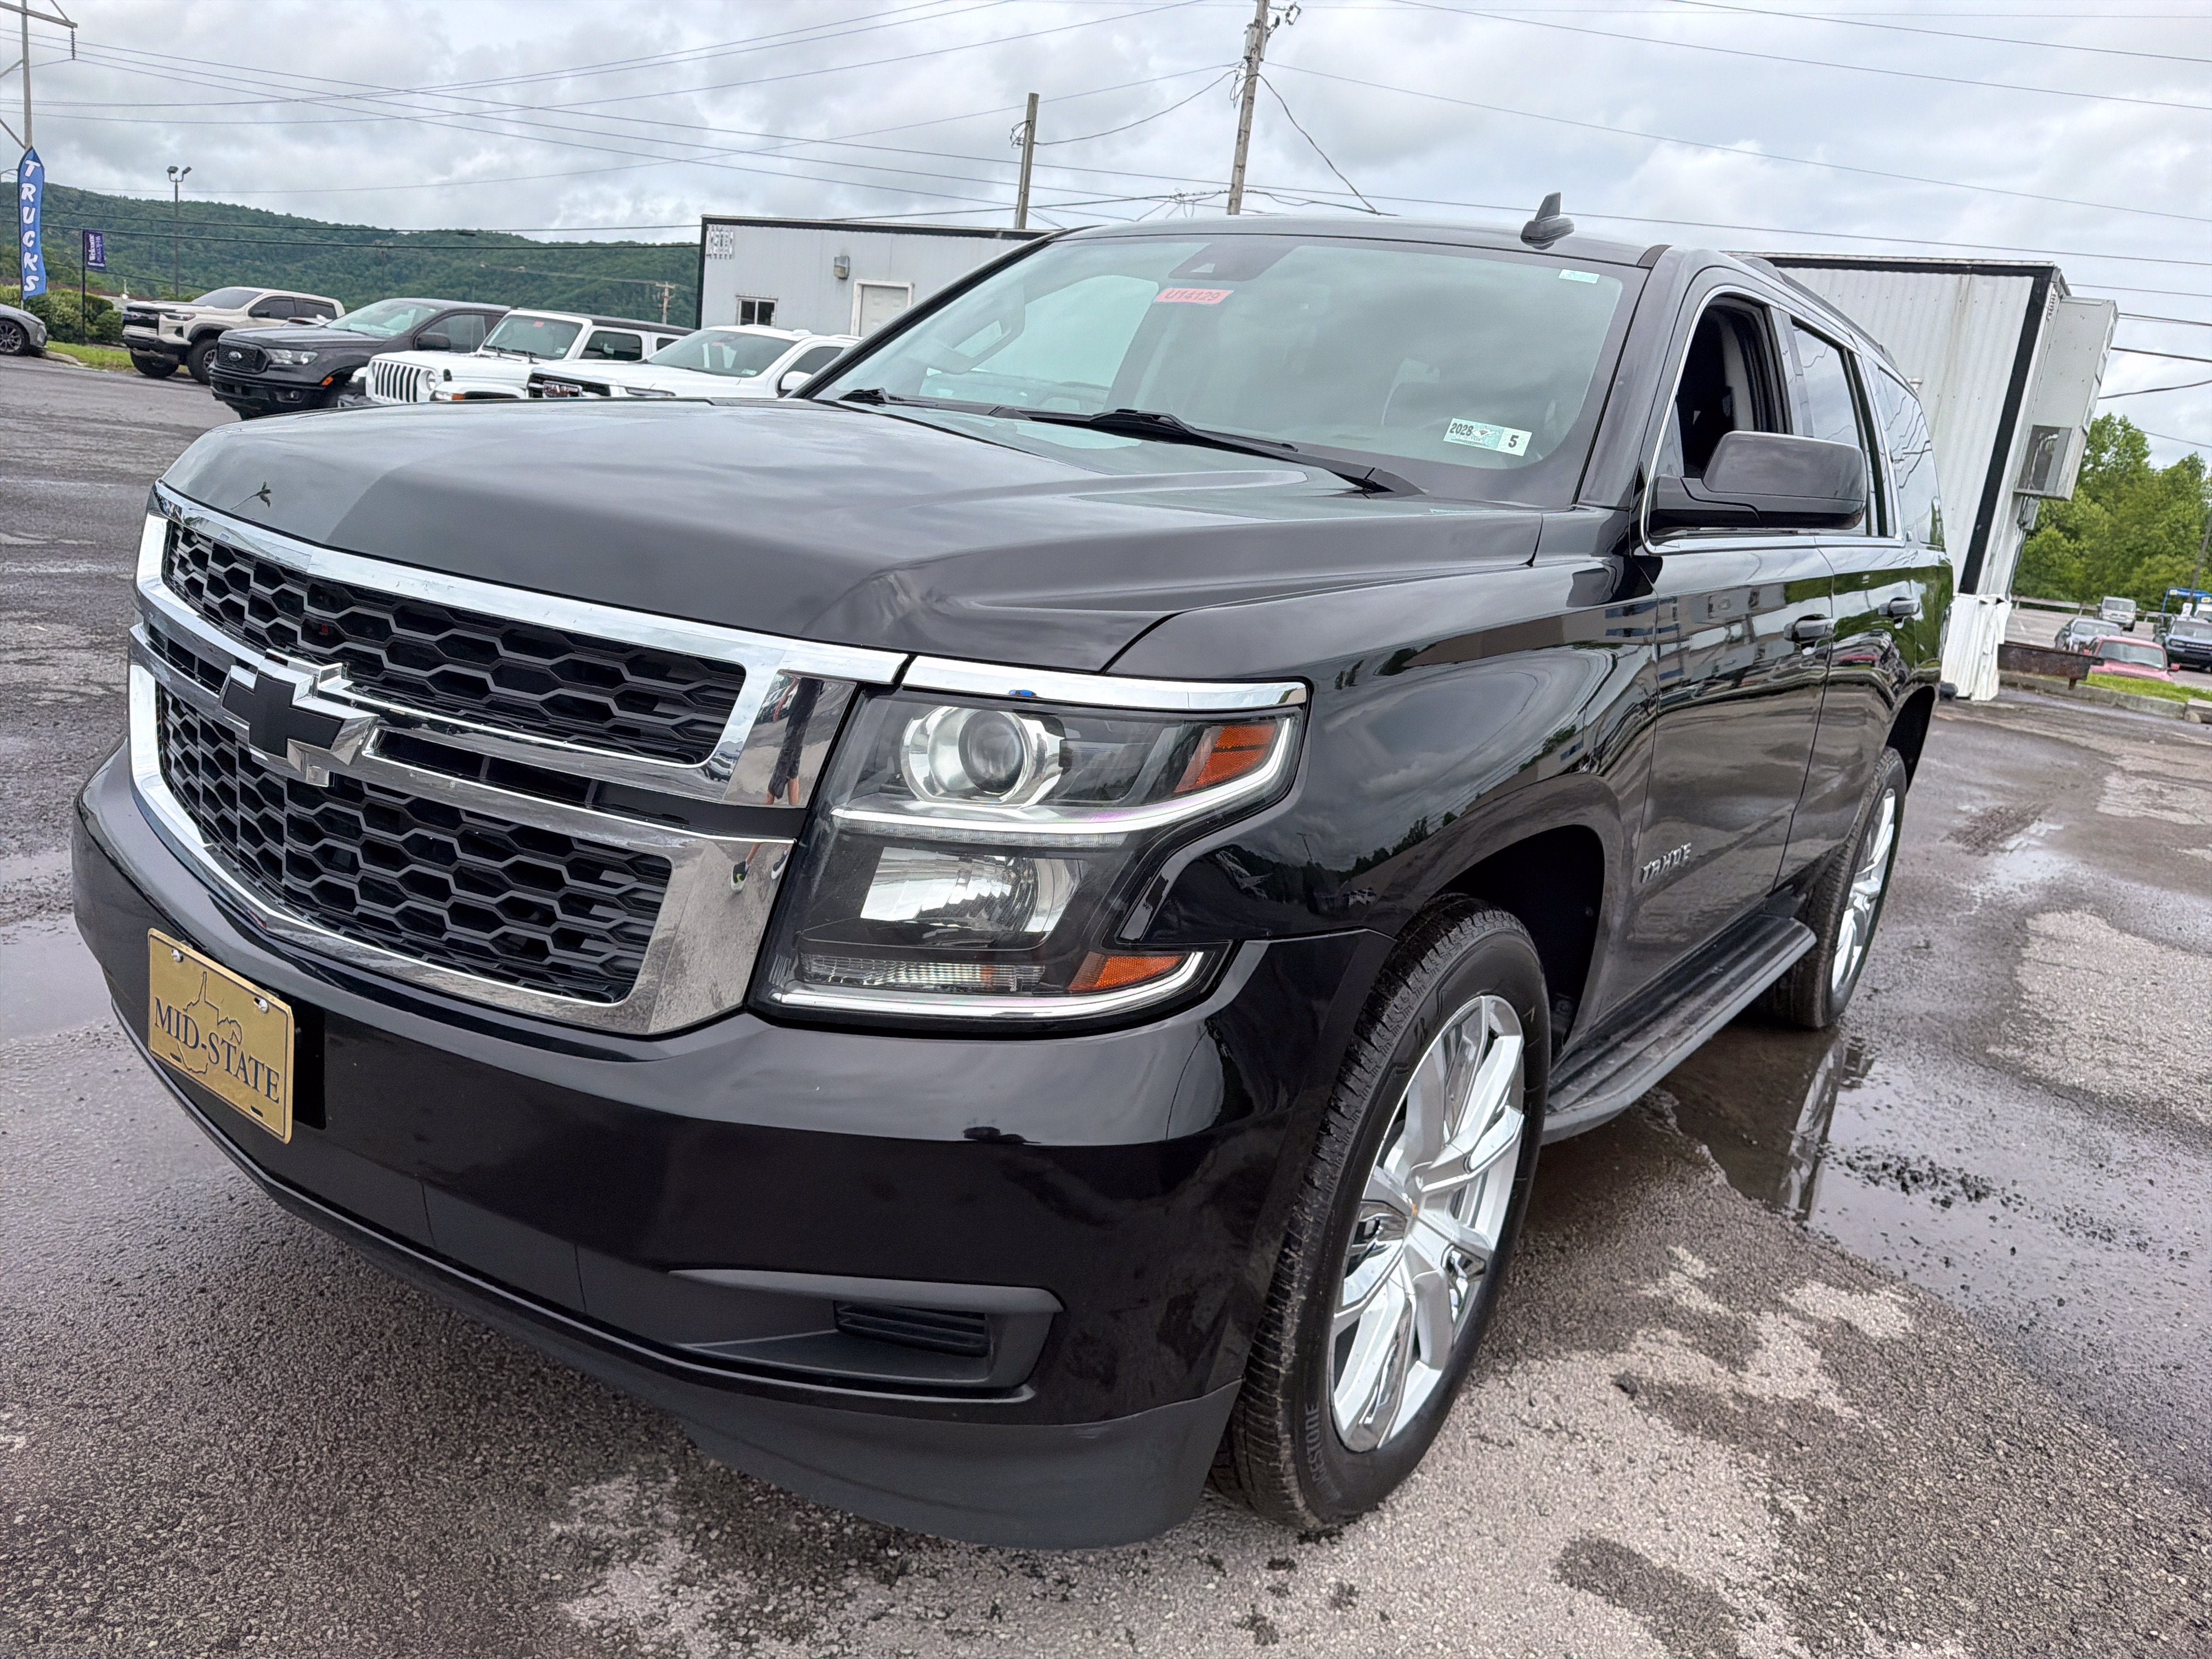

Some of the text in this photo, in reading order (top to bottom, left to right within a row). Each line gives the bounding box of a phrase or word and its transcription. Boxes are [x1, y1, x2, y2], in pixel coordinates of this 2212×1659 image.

[21, 160, 41, 292] TRUCKS
[1449, 422, 1520, 448] 2028 5
[1639, 842, 1692, 884] TAHOE
[154, 996, 280, 1104] MID-STATE
